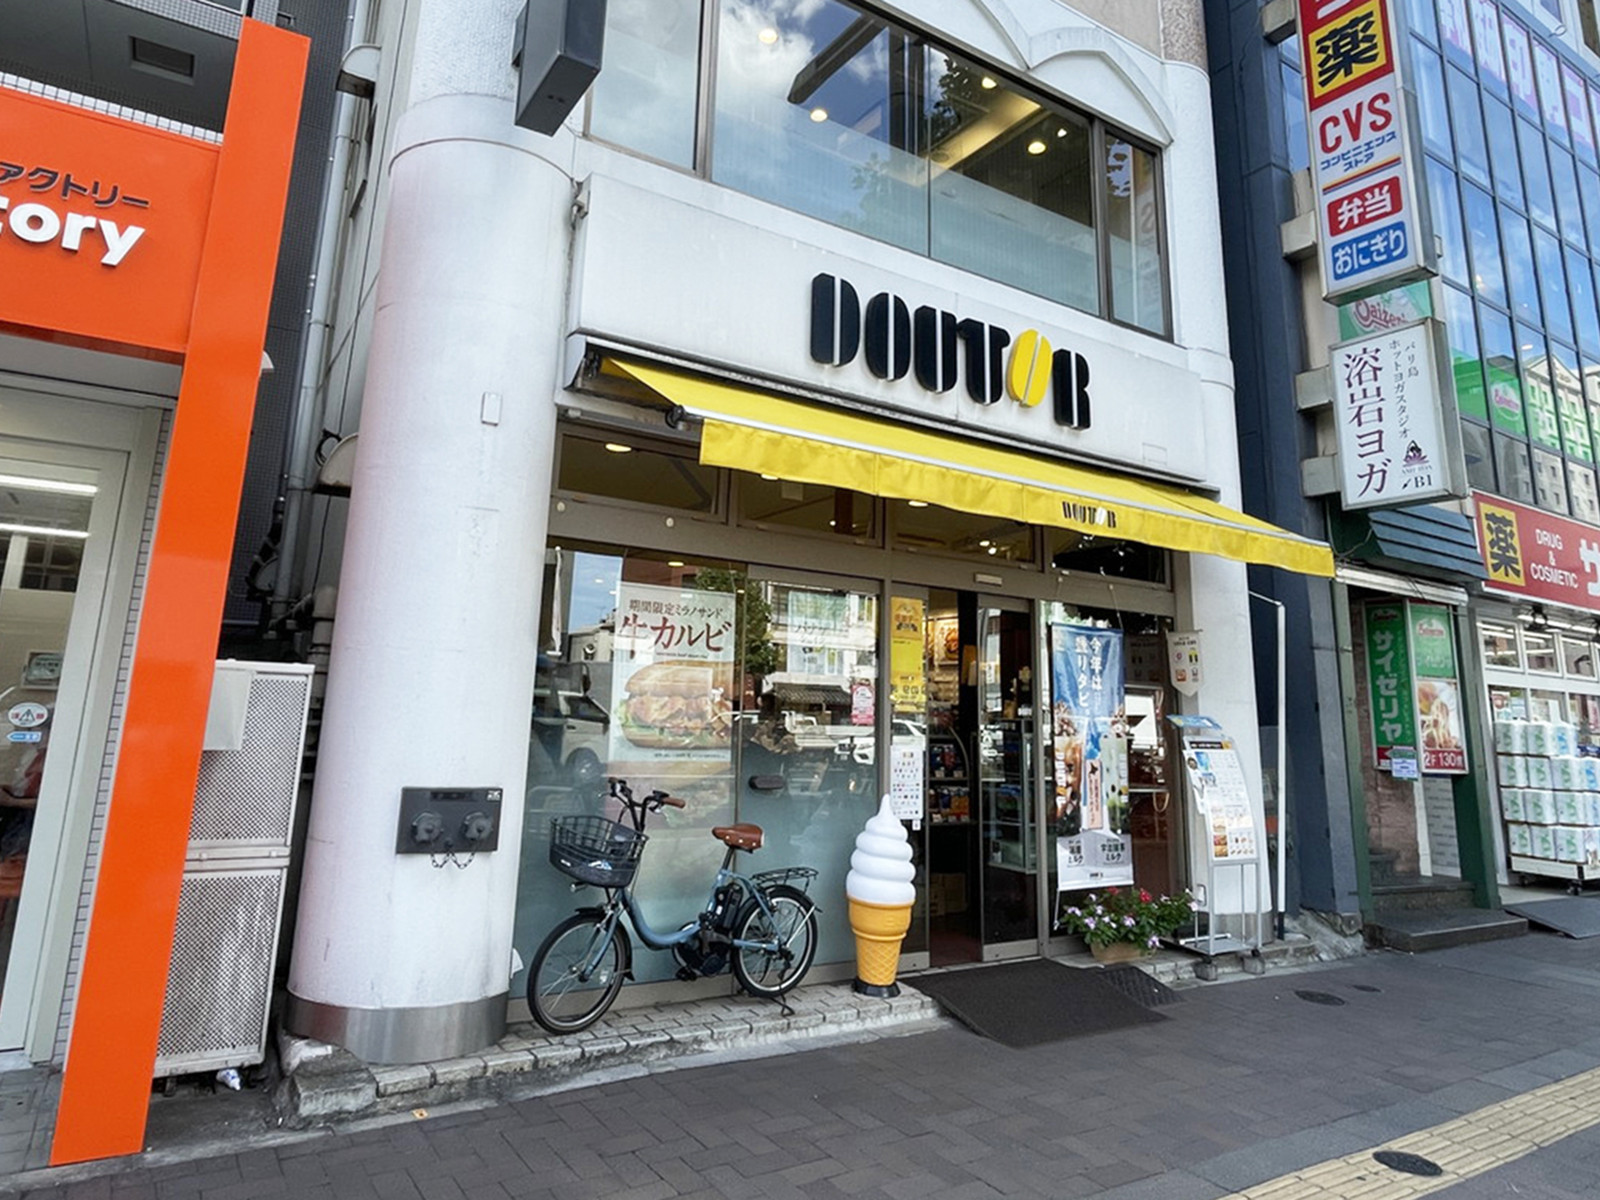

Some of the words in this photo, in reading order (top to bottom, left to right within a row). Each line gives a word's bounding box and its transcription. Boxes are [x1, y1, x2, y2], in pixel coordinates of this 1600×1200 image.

[1315, 10, 1379, 88] 薬
[1319, 92, 1393, 154] CVS
[1320, 131, 1397, 171] コンビニエンス
[1343, 152, 1374, 172] ストア
[1337, 185, 1393, 230] 弁当
[1334, 229, 1405, 275] おにぎり
[809, 272, 1092, 431] DOUTOR
[1343, 347, 1392, 498] 溶岩ヨガ
[1414, 473, 1433, 488] B1
[1484, 512, 1521, 578] 薬
[1534, 528, 1563, 550] DRUG
[1530, 562, 1578, 589] COSMETIC
[619, 612, 733, 660] 牛カルビ
[1372, 630, 1402, 742] サイゼリヤ
